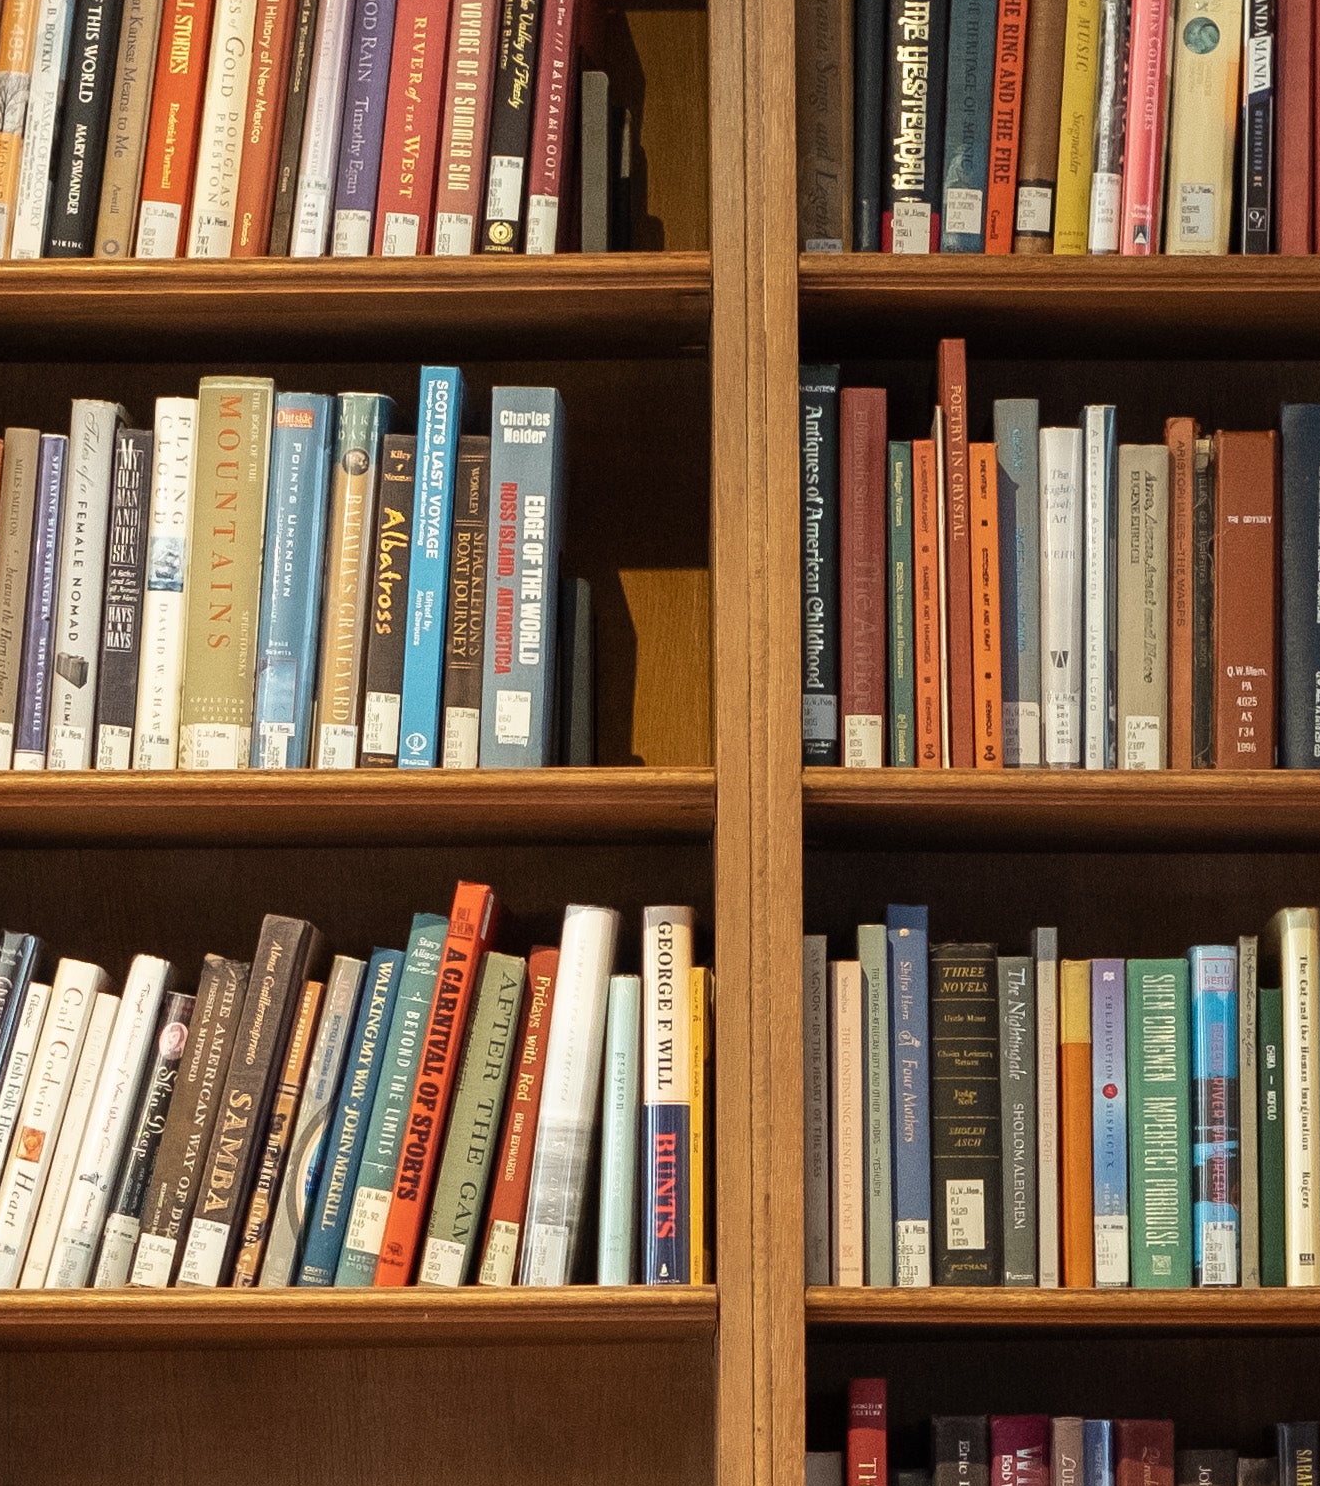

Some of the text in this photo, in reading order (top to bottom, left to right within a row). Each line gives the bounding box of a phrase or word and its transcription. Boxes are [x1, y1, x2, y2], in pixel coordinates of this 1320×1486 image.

[85, 7, 101, 40] THIS
[170, 15, 193, 74] STORIES
[1001, 23, 1020, 63] RING
[79, 45, 98, 103] WORLD
[357, 37, 376, 82] RAIN
[999, 69, 1016, 103] AND
[73, 124, 88, 156] MARY
[348, 97, 370, 155] Timothy
[893, 45, 930, 190] YESTERDAY
[996, 109, 1013, 142] THE
[67, 160, 84, 214] SWANDER
[344, 159, 365, 194] Egan
[993, 148, 1011, 184] FIRE
[424, 380, 449, 558] SCOTT'S LAST VOYAGE
[950, 384, 965, 541] POETRY IN CRYSTAL
[208, 394, 242, 650] MOUNTAINS
[801, 405, 825, 689] Antiques of American Childhood
[375, 507, 409, 635] Albatross
[519, 495, 545, 665] EDGE OF THE WORLD
[4, 987, 84, 1230] Gail Godwin Heart
[655, 921, 676, 1238] GEORGE F. WILL BUNTS
[1006, 968, 1026, 1230] The Nightingale SHOLOM ALEICHEM
[1142, 973, 1180, 1247] SHEN CONGWEN IMPERFECT PARADISE
